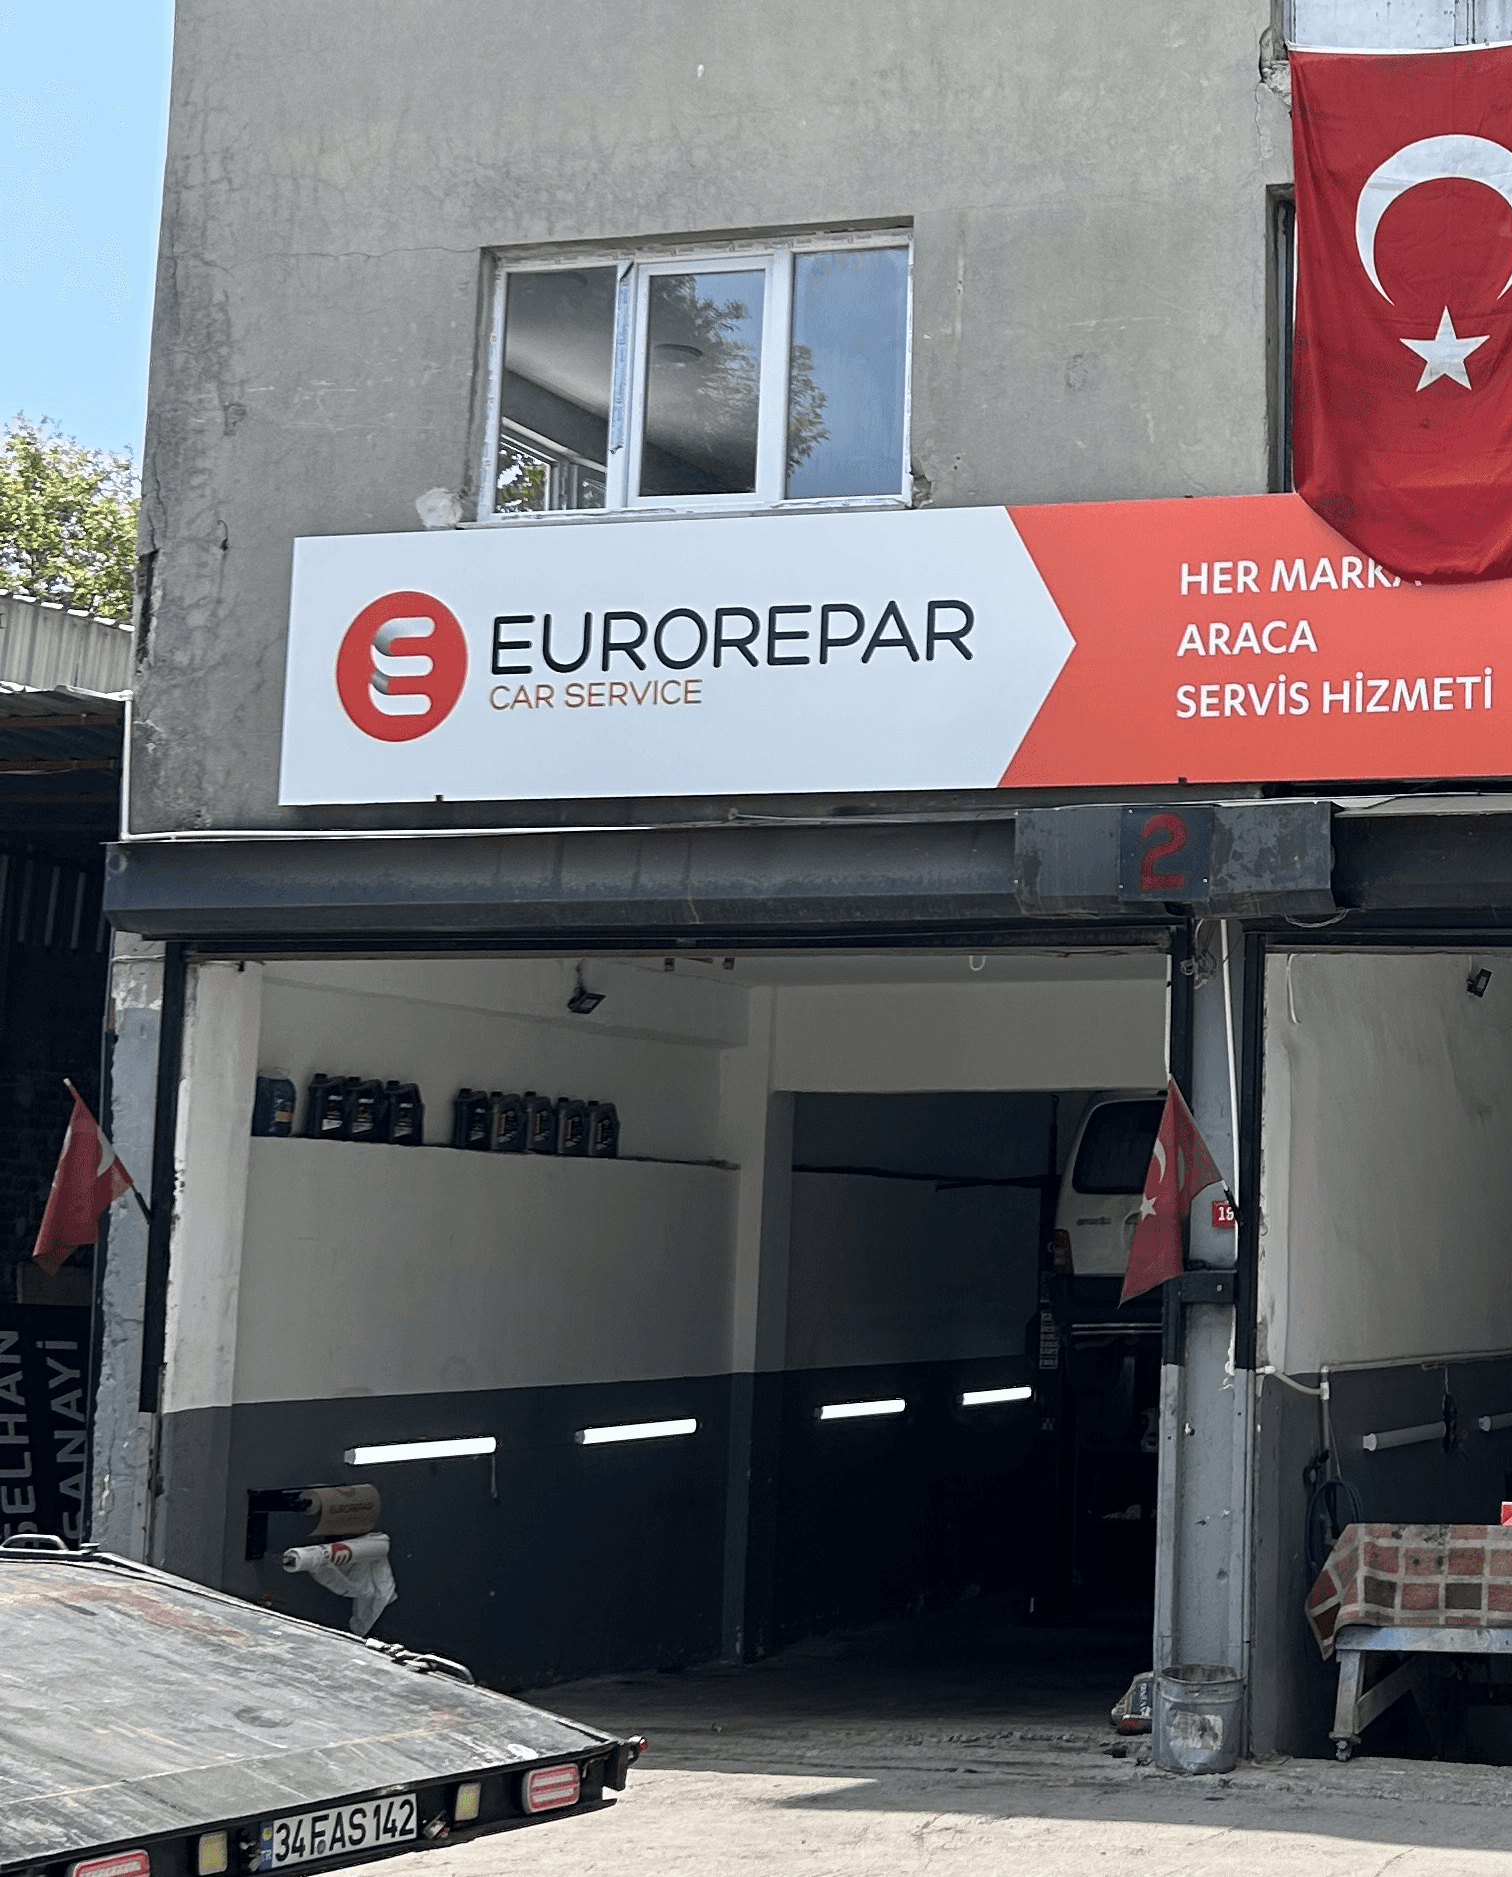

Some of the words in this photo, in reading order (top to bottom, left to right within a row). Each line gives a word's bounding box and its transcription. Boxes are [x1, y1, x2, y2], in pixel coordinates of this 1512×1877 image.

[1180, 560, 1261, 596] HER
[1270, 555, 1422, 593] MARK
[491, 599, 975, 676] EUROREPAR
[1176, 619, 1318, 657] ARACA
[490, 683, 559, 711] CAR
[564, 678, 703, 709] SERVICE
[1176, 673, 1311, 719] SERVİS
[1322, 666, 1493, 715] HİZMETİ
[1139, 811, 1188, 891] 2
[274, 1817, 307, 1863] 34
[309, 1807, 367, 1857] FAS
[372, 1797, 417, 1843] 142
